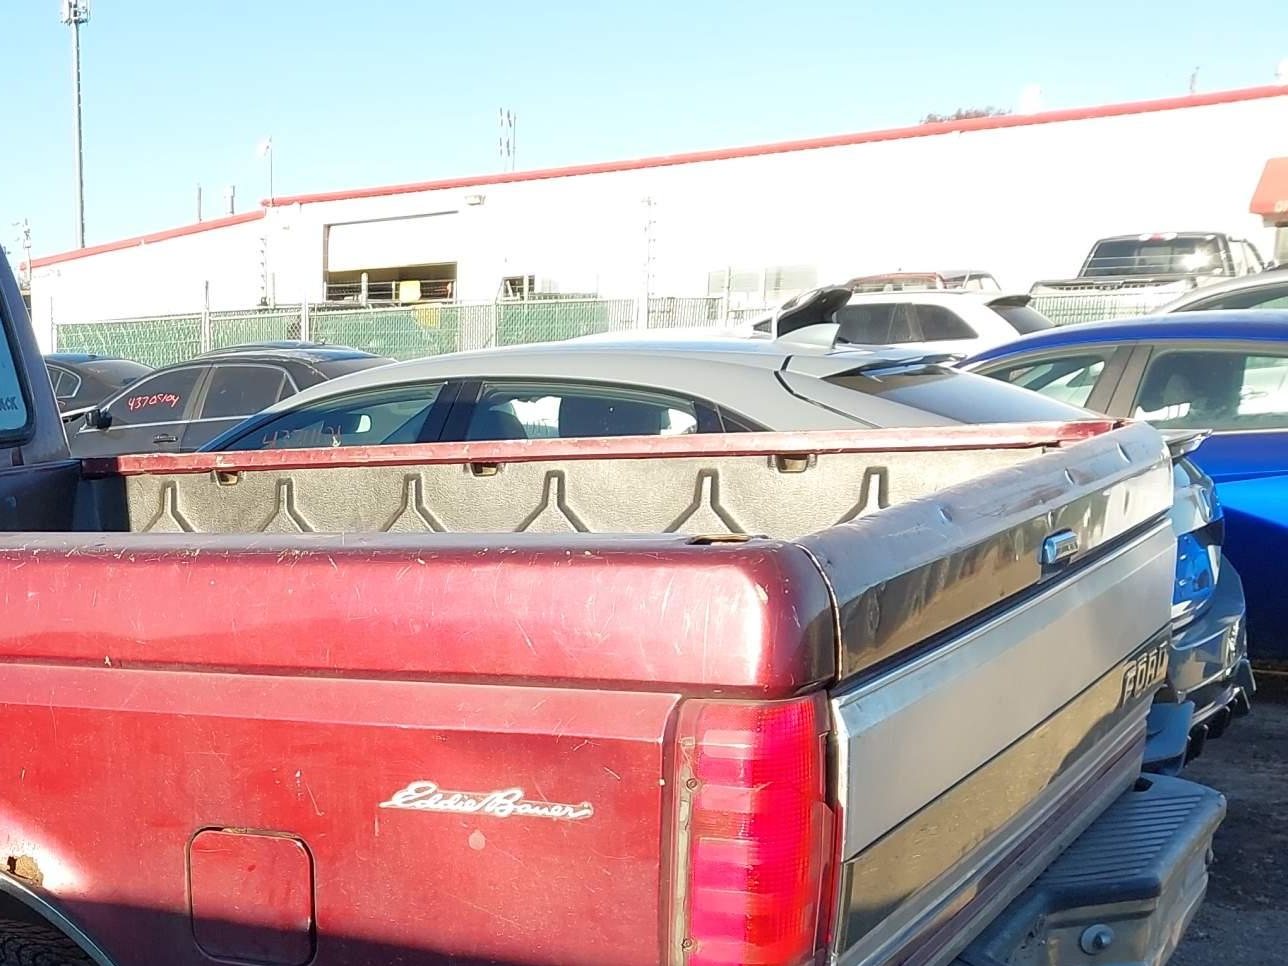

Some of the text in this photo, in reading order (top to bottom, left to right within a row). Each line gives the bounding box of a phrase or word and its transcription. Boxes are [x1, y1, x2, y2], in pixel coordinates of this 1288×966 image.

[1122, 641, 1169, 704] FORD
[378, 780, 593, 818] Eddie Bauer
